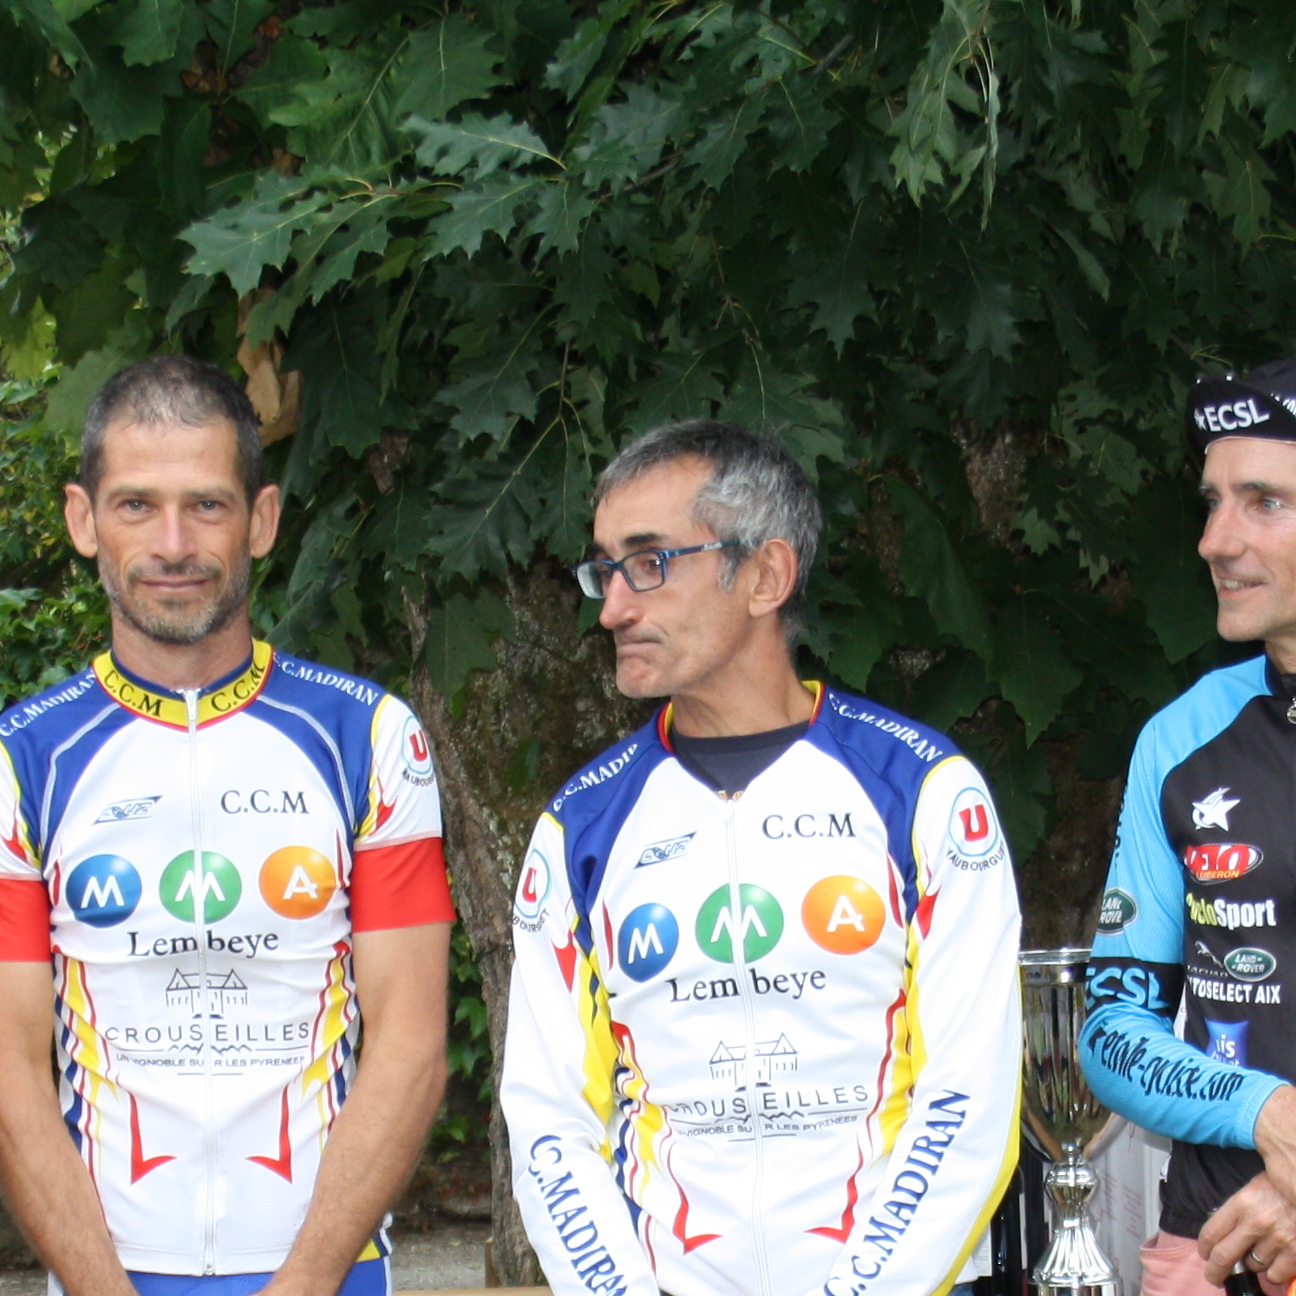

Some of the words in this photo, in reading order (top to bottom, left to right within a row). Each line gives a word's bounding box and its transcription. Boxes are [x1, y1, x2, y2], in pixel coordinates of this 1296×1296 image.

[1204, 399, 1270, 432] ECSL
[221, 789, 310, 815] C.C.M
[762, 812, 857, 840] C.C.M
[80, 875, 125, 909] M
[282, 865, 318, 900] A
[627, 923, 664, 964] M
[827, 896, 865, 933] A
[1255, 985, 1281, 1004] AIX
[105, 1022, 310, 1044] CROUSEILLES
